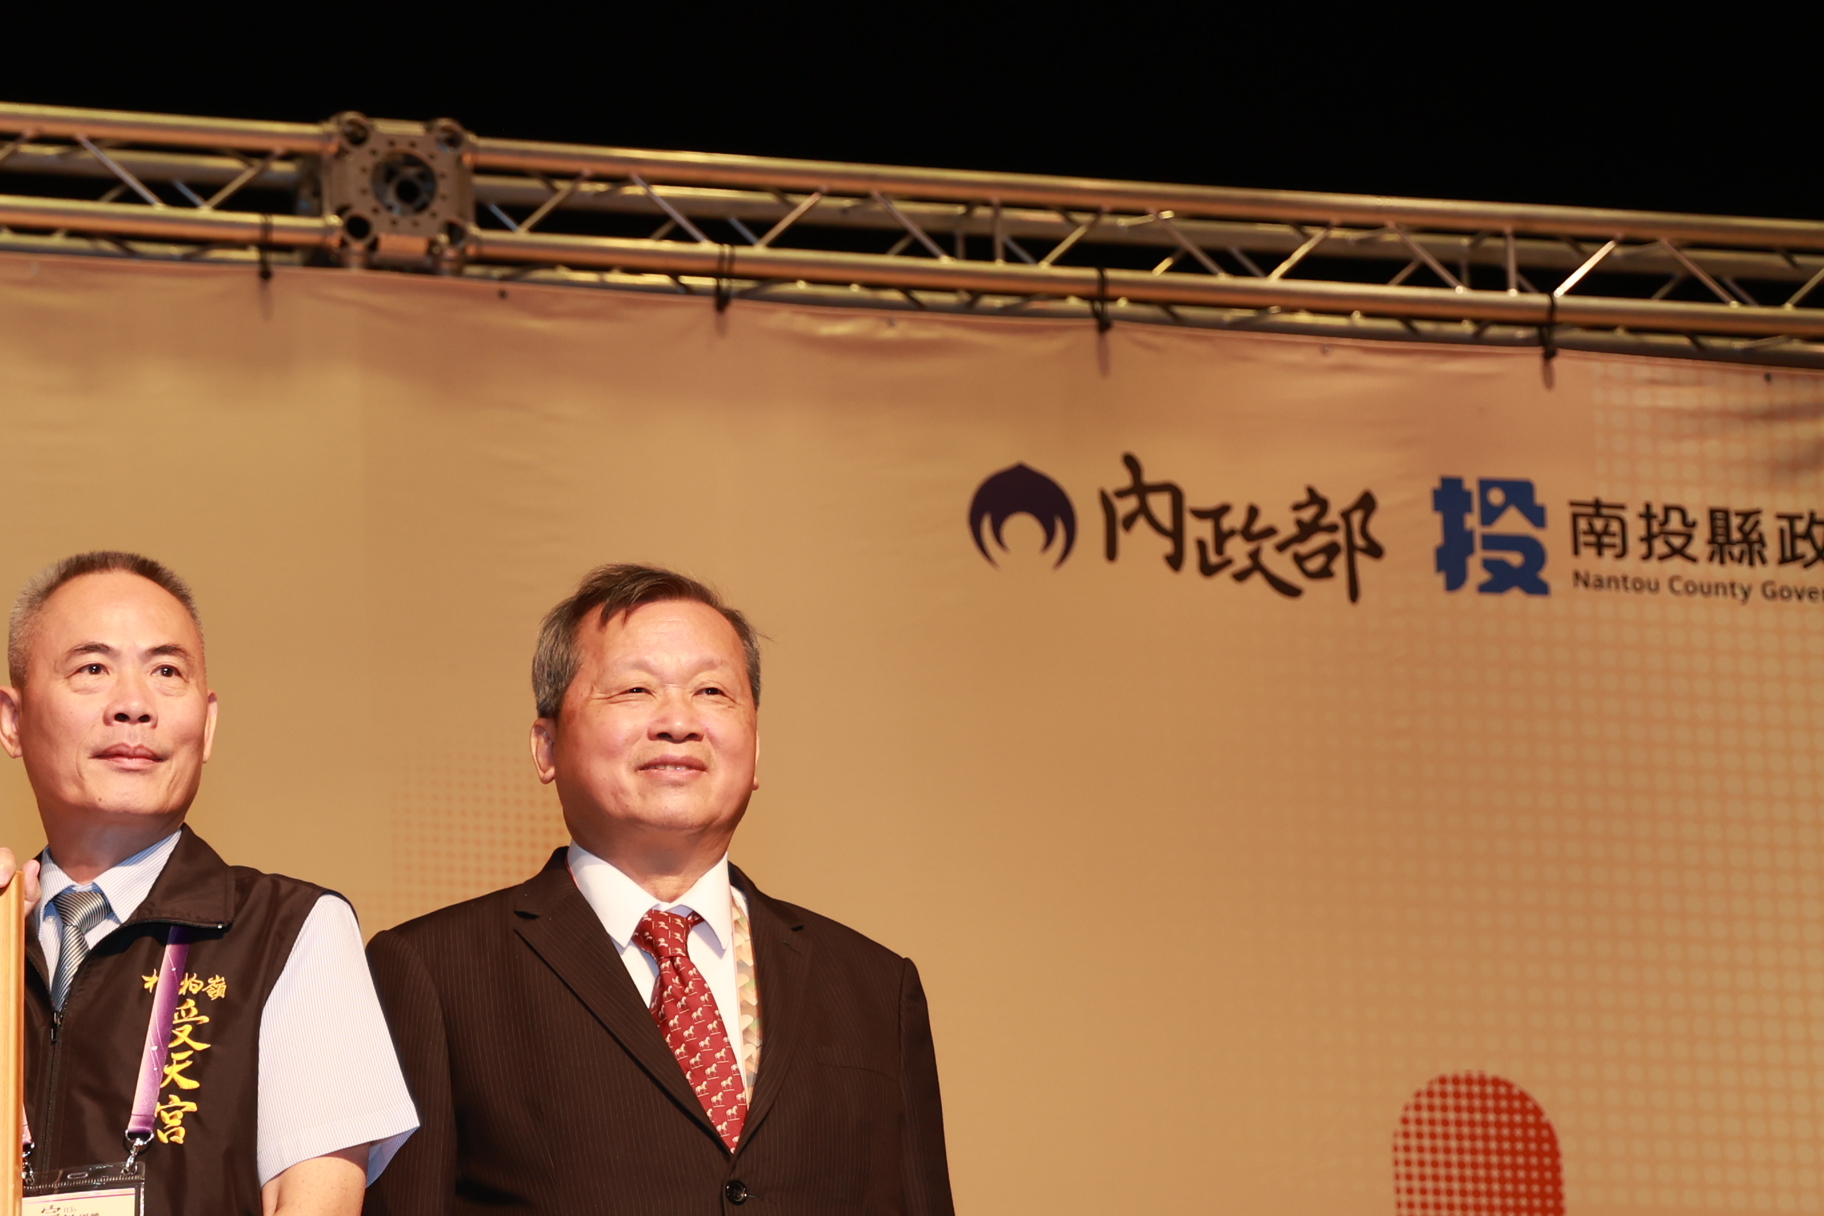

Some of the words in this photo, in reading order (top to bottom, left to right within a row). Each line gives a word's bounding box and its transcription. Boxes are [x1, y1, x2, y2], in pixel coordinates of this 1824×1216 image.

[1569, 496, 1824, 570] 南投縣政
[1573, 570, 1660, 594] Nantou
[1668, 574, 1752, 605] County
[1761, 579, 1824, 602] Gove
[154, 998, 212, 1145] 受天宮
